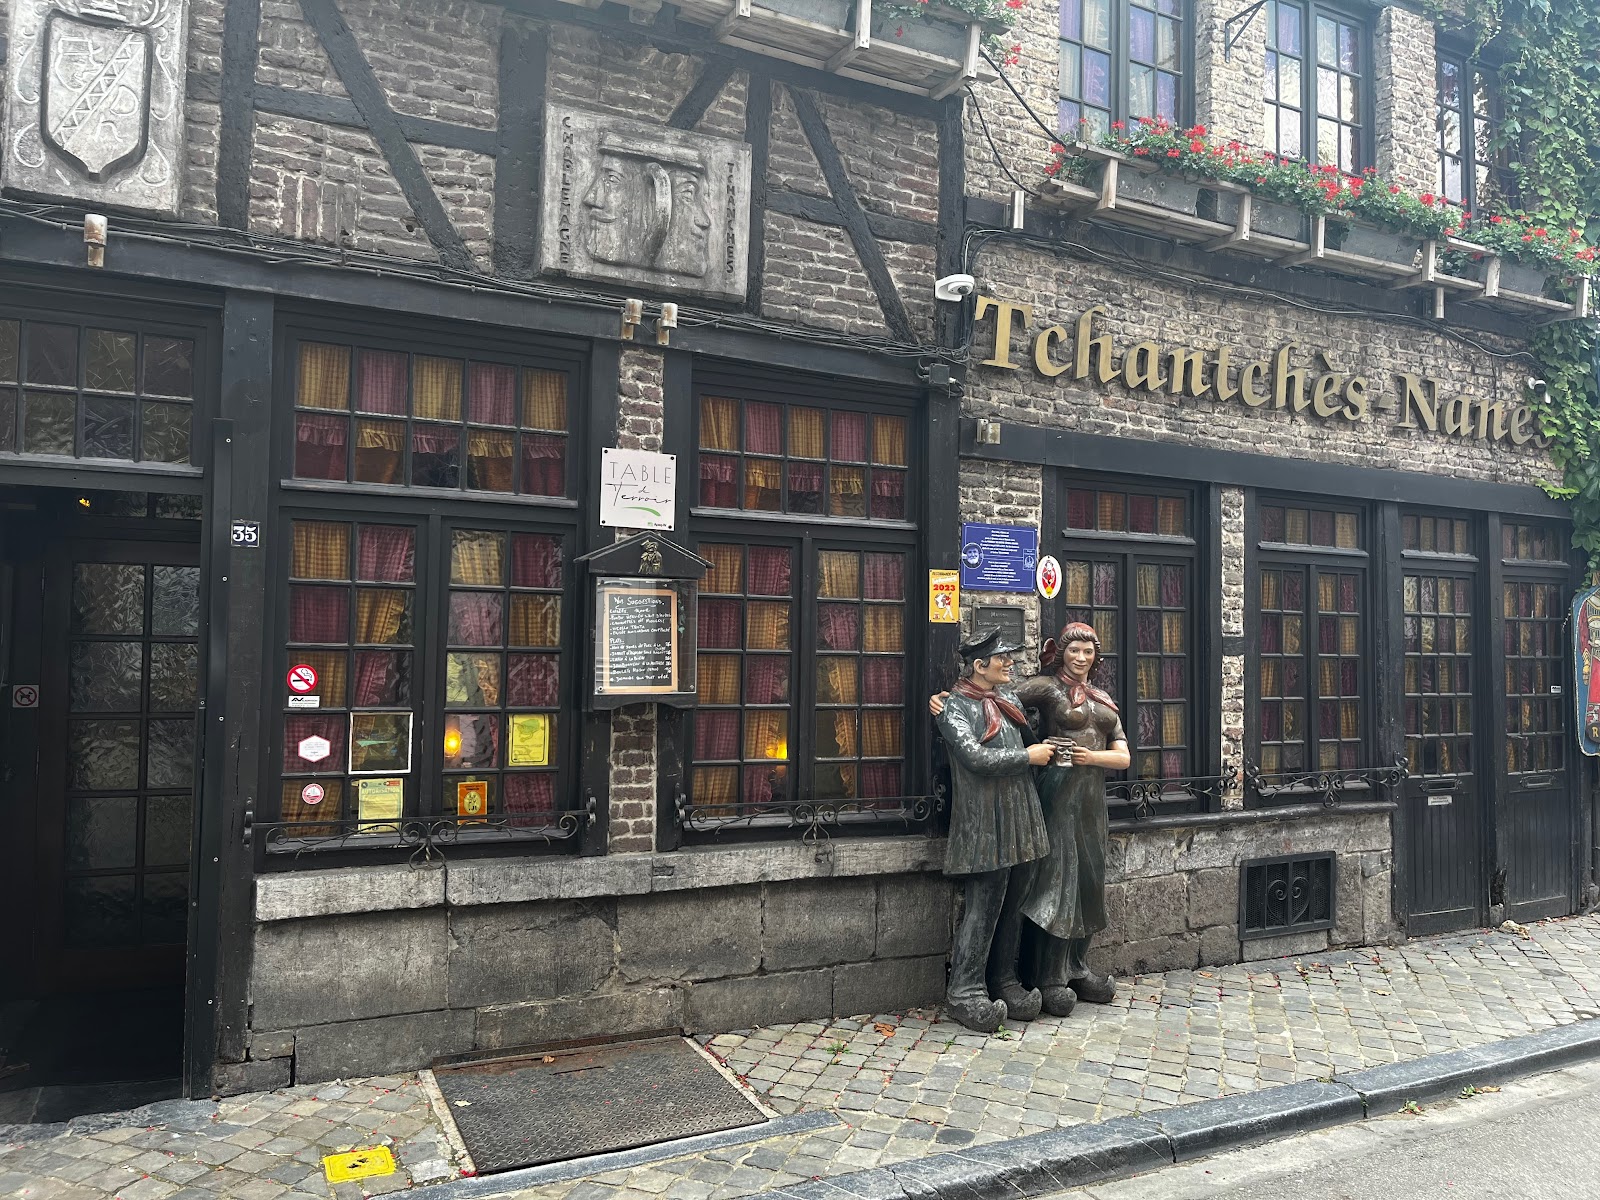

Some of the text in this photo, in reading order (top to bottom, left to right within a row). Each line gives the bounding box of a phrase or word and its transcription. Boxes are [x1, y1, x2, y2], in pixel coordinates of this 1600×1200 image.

[974, 295, 1368, 421] Tchantchès
[609, 461, 672, 484] TABLE
[232, 525, 257, 542] 35
[933, 583, 956, 592] 2023
[1591, 726, 1599, 738] R
